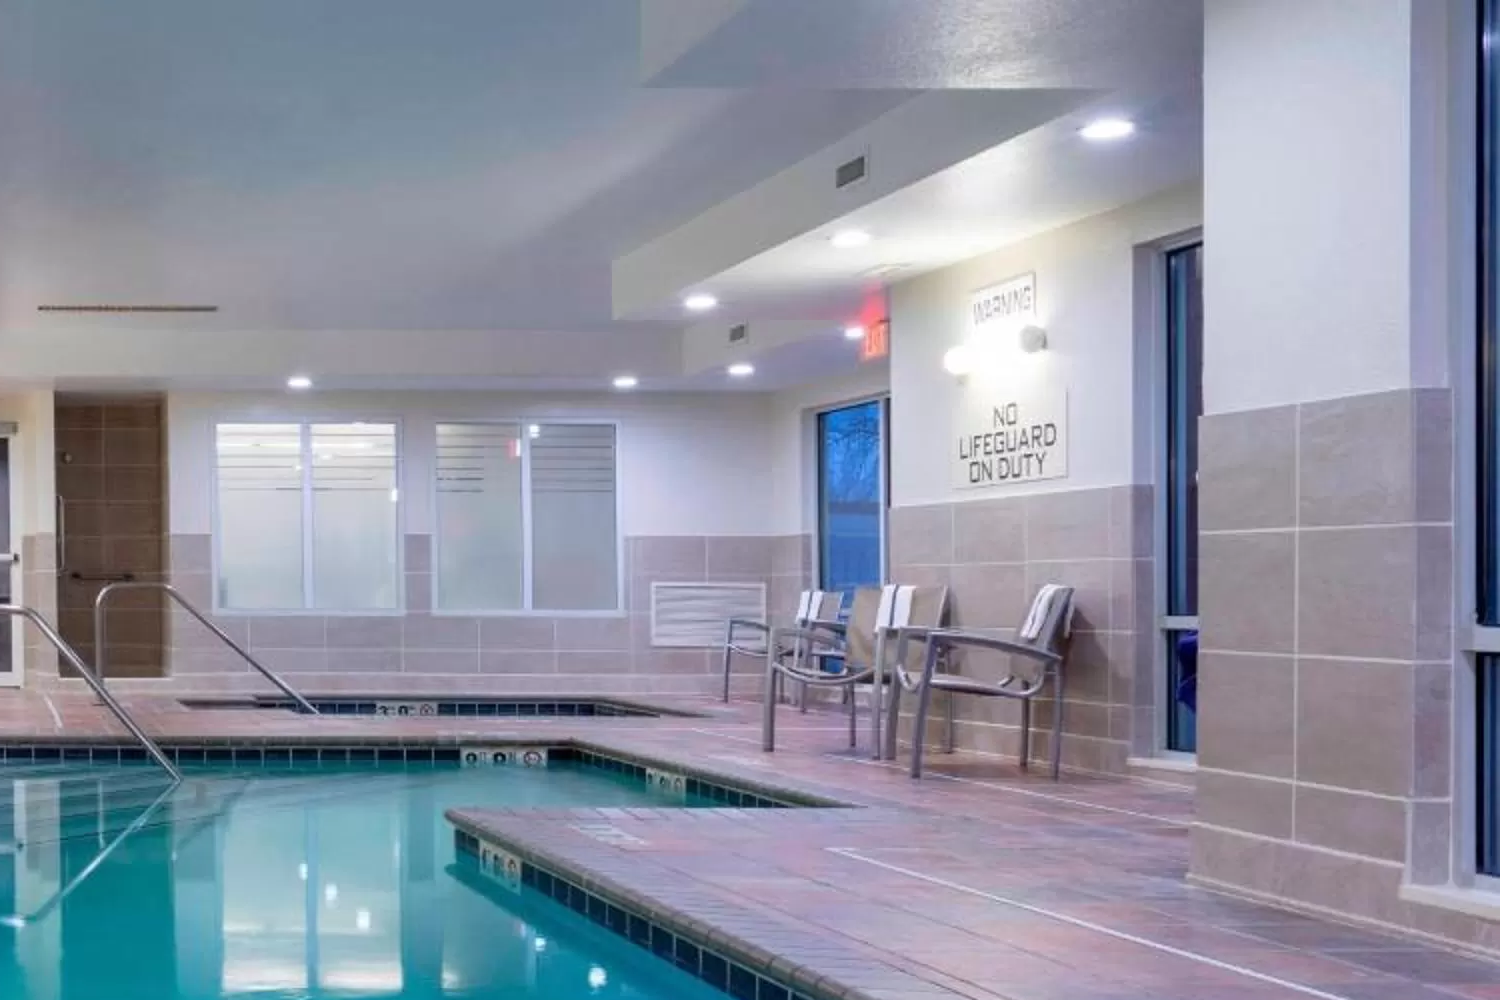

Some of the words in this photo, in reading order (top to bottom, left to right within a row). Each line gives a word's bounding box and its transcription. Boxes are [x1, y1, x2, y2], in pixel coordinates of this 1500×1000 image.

[973, 285, 1031, 325] WARNING
[994, 402, 1017, 428] NO
[960, 423, 1057, 459] LIFEGUARD
[969, 459, 992, 482] ON
[998, 452, 1046, 479] DUTY
